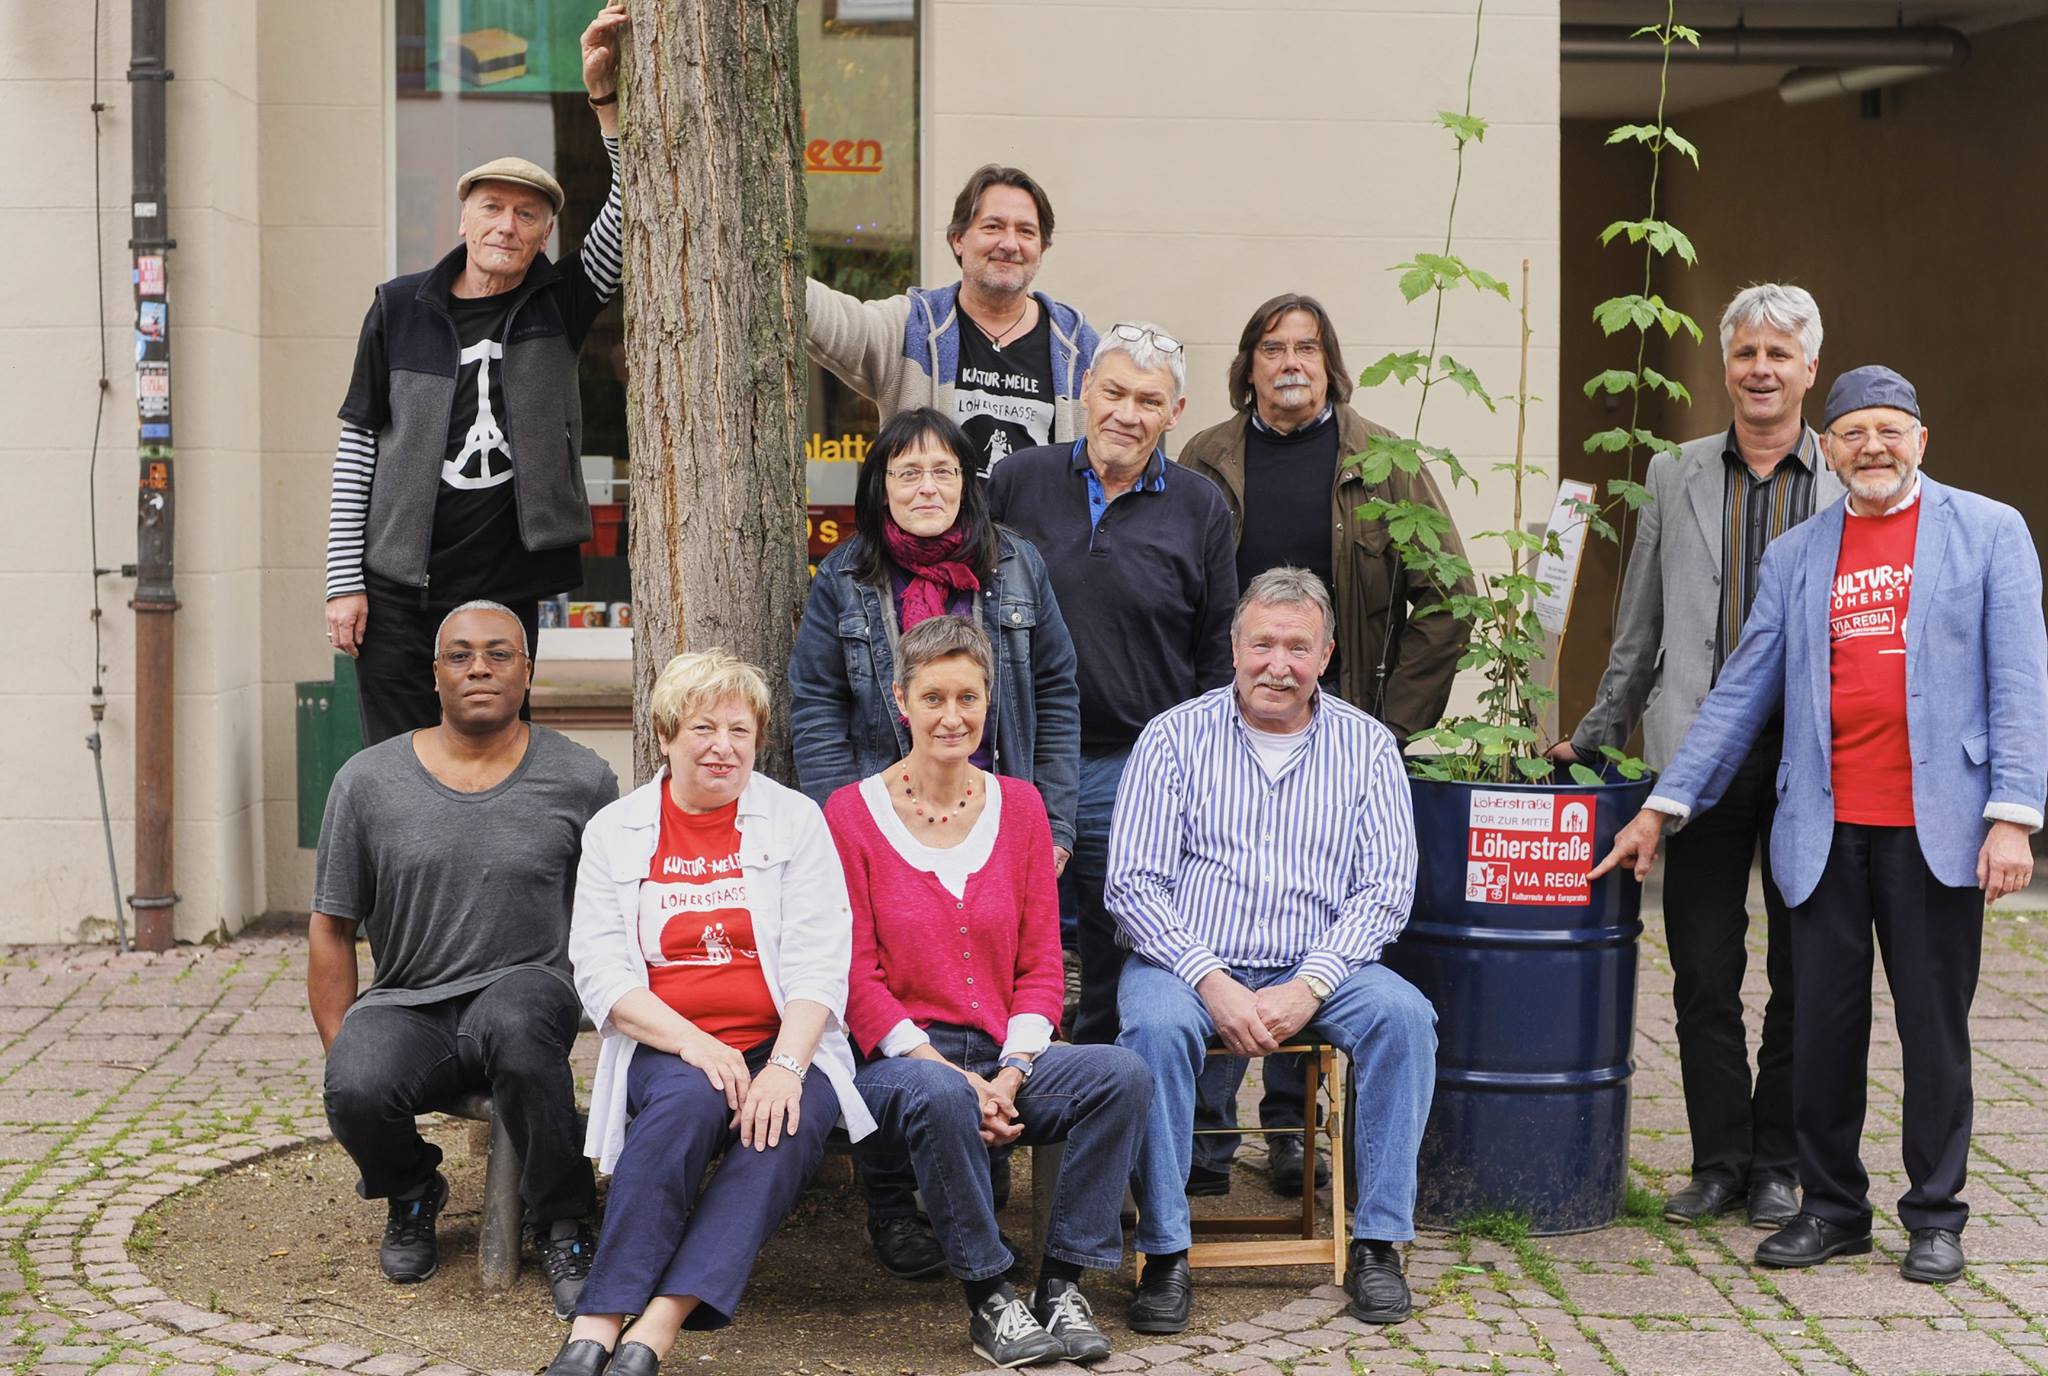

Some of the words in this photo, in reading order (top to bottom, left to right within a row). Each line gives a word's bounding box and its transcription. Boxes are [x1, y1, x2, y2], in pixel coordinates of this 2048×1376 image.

[1832, 619, 1851, 632] VIA
[1852, 612, 1890, 628] REGIA
[1474, 814, 1495, 824] TOR
[1498, 816, 1518, 826] ZUR
[1521, 818, 1550, 828] MITTE
[1471, 831, 1590, 861] Löherstraße
[1513, 871, 1540, 886] VIA
[1544, 872, 1588, 888] REGIA
